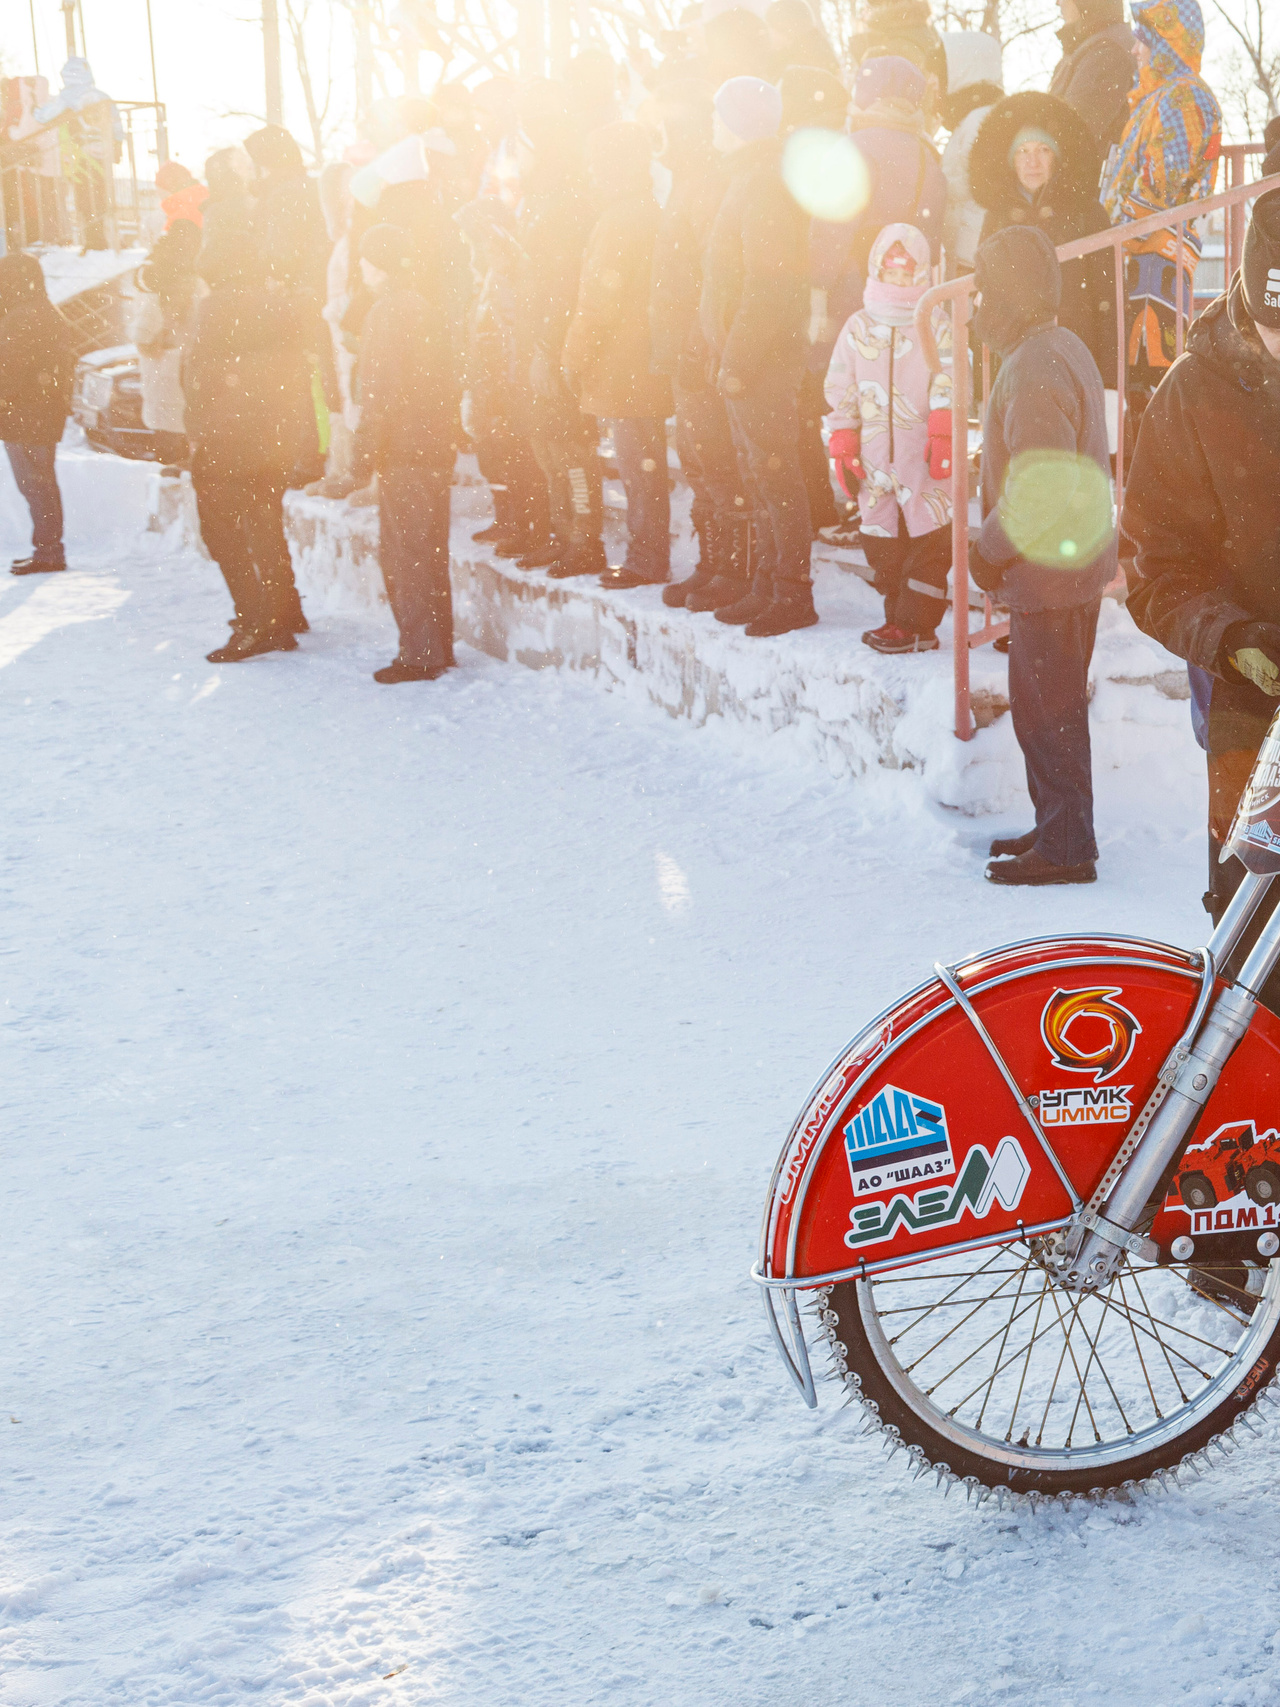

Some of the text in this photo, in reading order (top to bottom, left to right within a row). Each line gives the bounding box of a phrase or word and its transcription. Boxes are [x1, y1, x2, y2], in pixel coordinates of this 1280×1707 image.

[1042, 1087, 1128, 1108] УГМК
[1042, 1105, 1128, 1124] UMMC
[858, 1175, 882, 1191] АО
[1194, 1206, 1259, 1232] ПДМ
